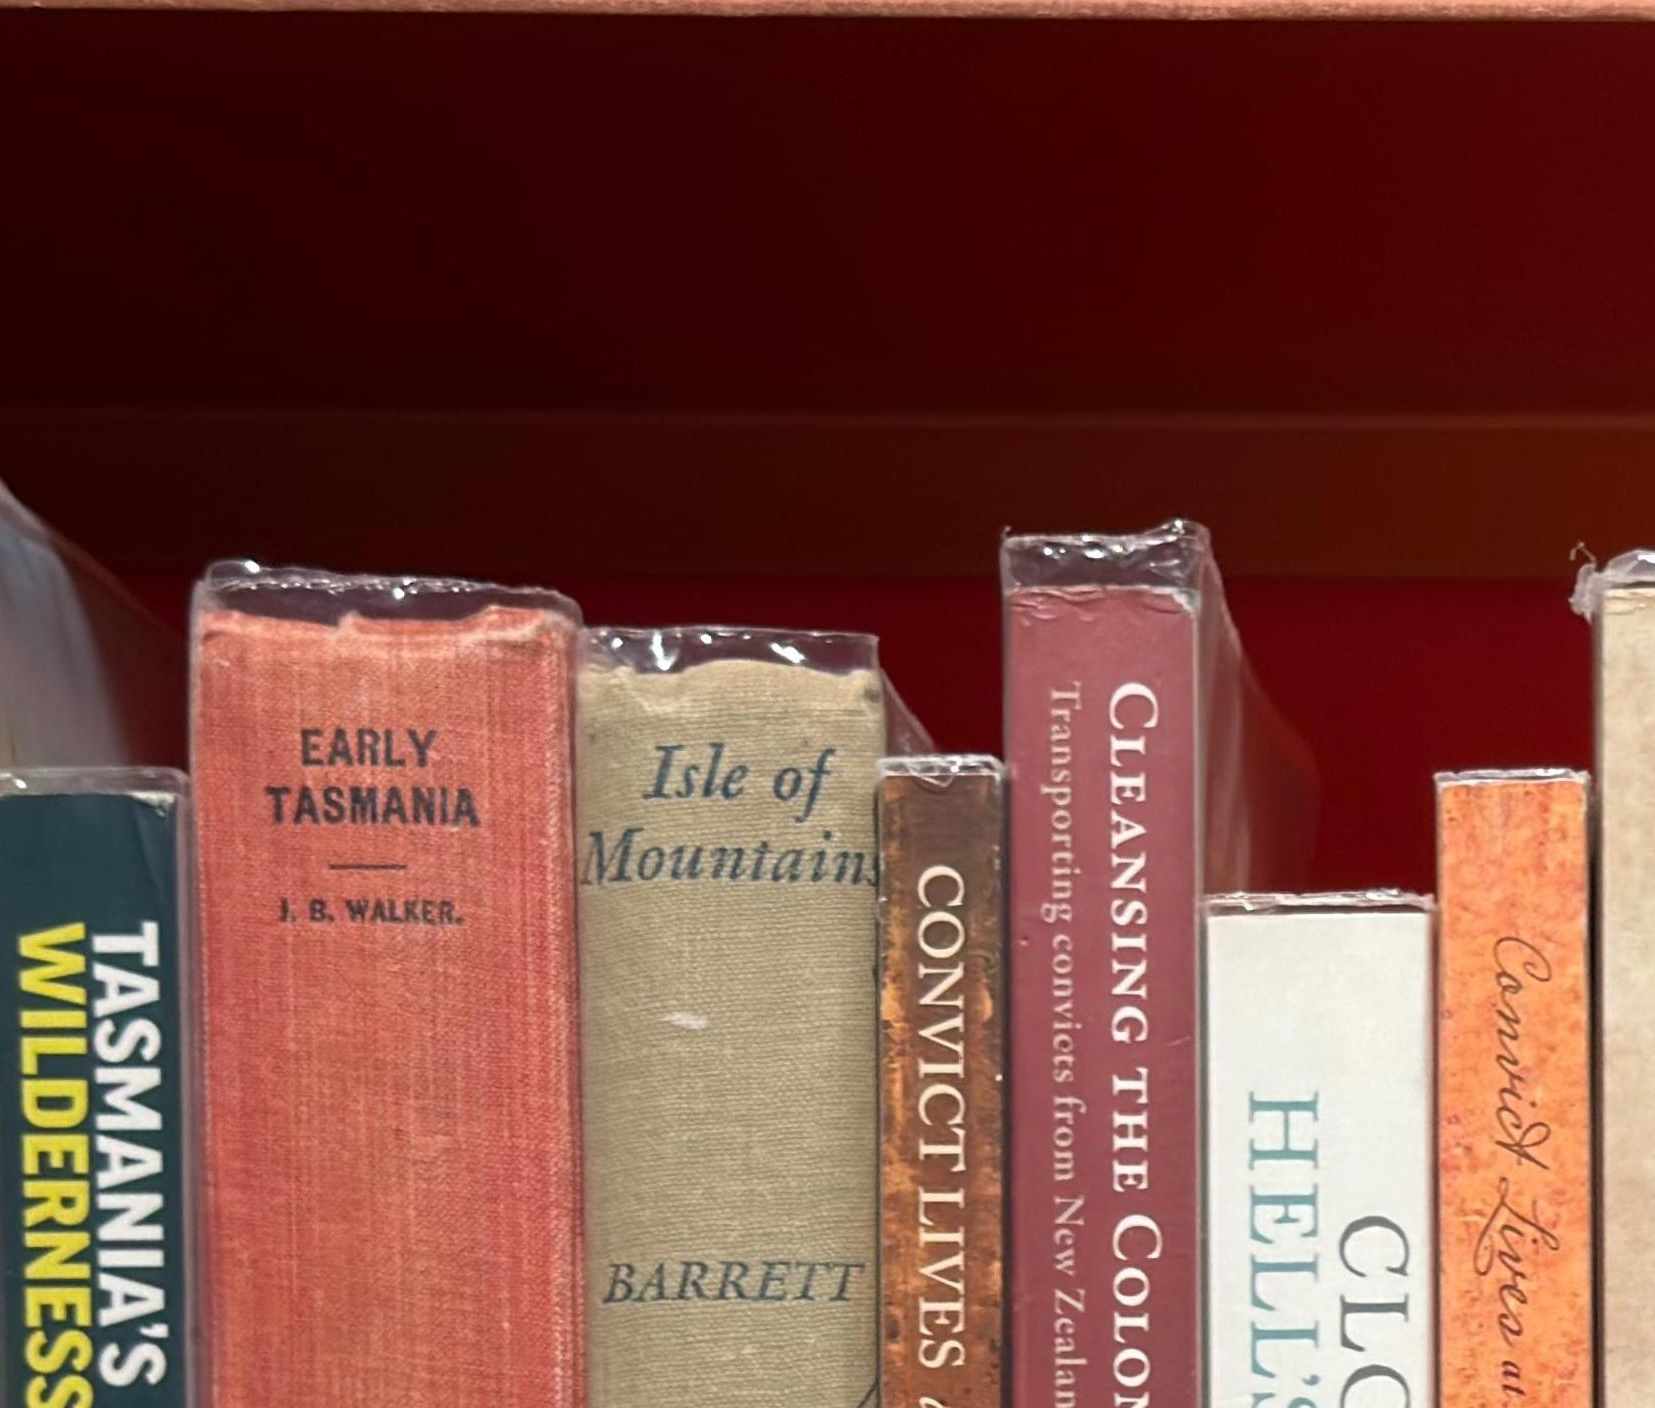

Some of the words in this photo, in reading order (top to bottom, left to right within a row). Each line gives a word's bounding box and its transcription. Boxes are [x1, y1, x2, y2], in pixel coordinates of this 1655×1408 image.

[264, 785, 481, 828] TASMANIA
[300, 728, 437, 767] EARLY
[642, 742, 751, 800] Isle
[773, 746, 837, 824] of
[1040, 681, 1083, 925] Transporting
[309, 898, 335, 924] B.
[1108, 681, 1159, 1044] CLEANSING
[916, 864, 966, 1173] CONVICT
[1051, 933, 1084, 1084] convicts
[1493, 935, 1552, 1170] Convict
[92, 920, 169, 1387] TASMANIA'S
[1053, 1095, 1087, 1182] from
[1112, 1067, 1150, 1193] THE
[602, 1259, 867, 1304] BARRETT
[917, 1186, 966, 1369] LIVES
[1054, 1196, 1086, 1277] New
[1473, 1176, 1561, 1348] Lives
[1501, 1359, 1528, 1397] at
